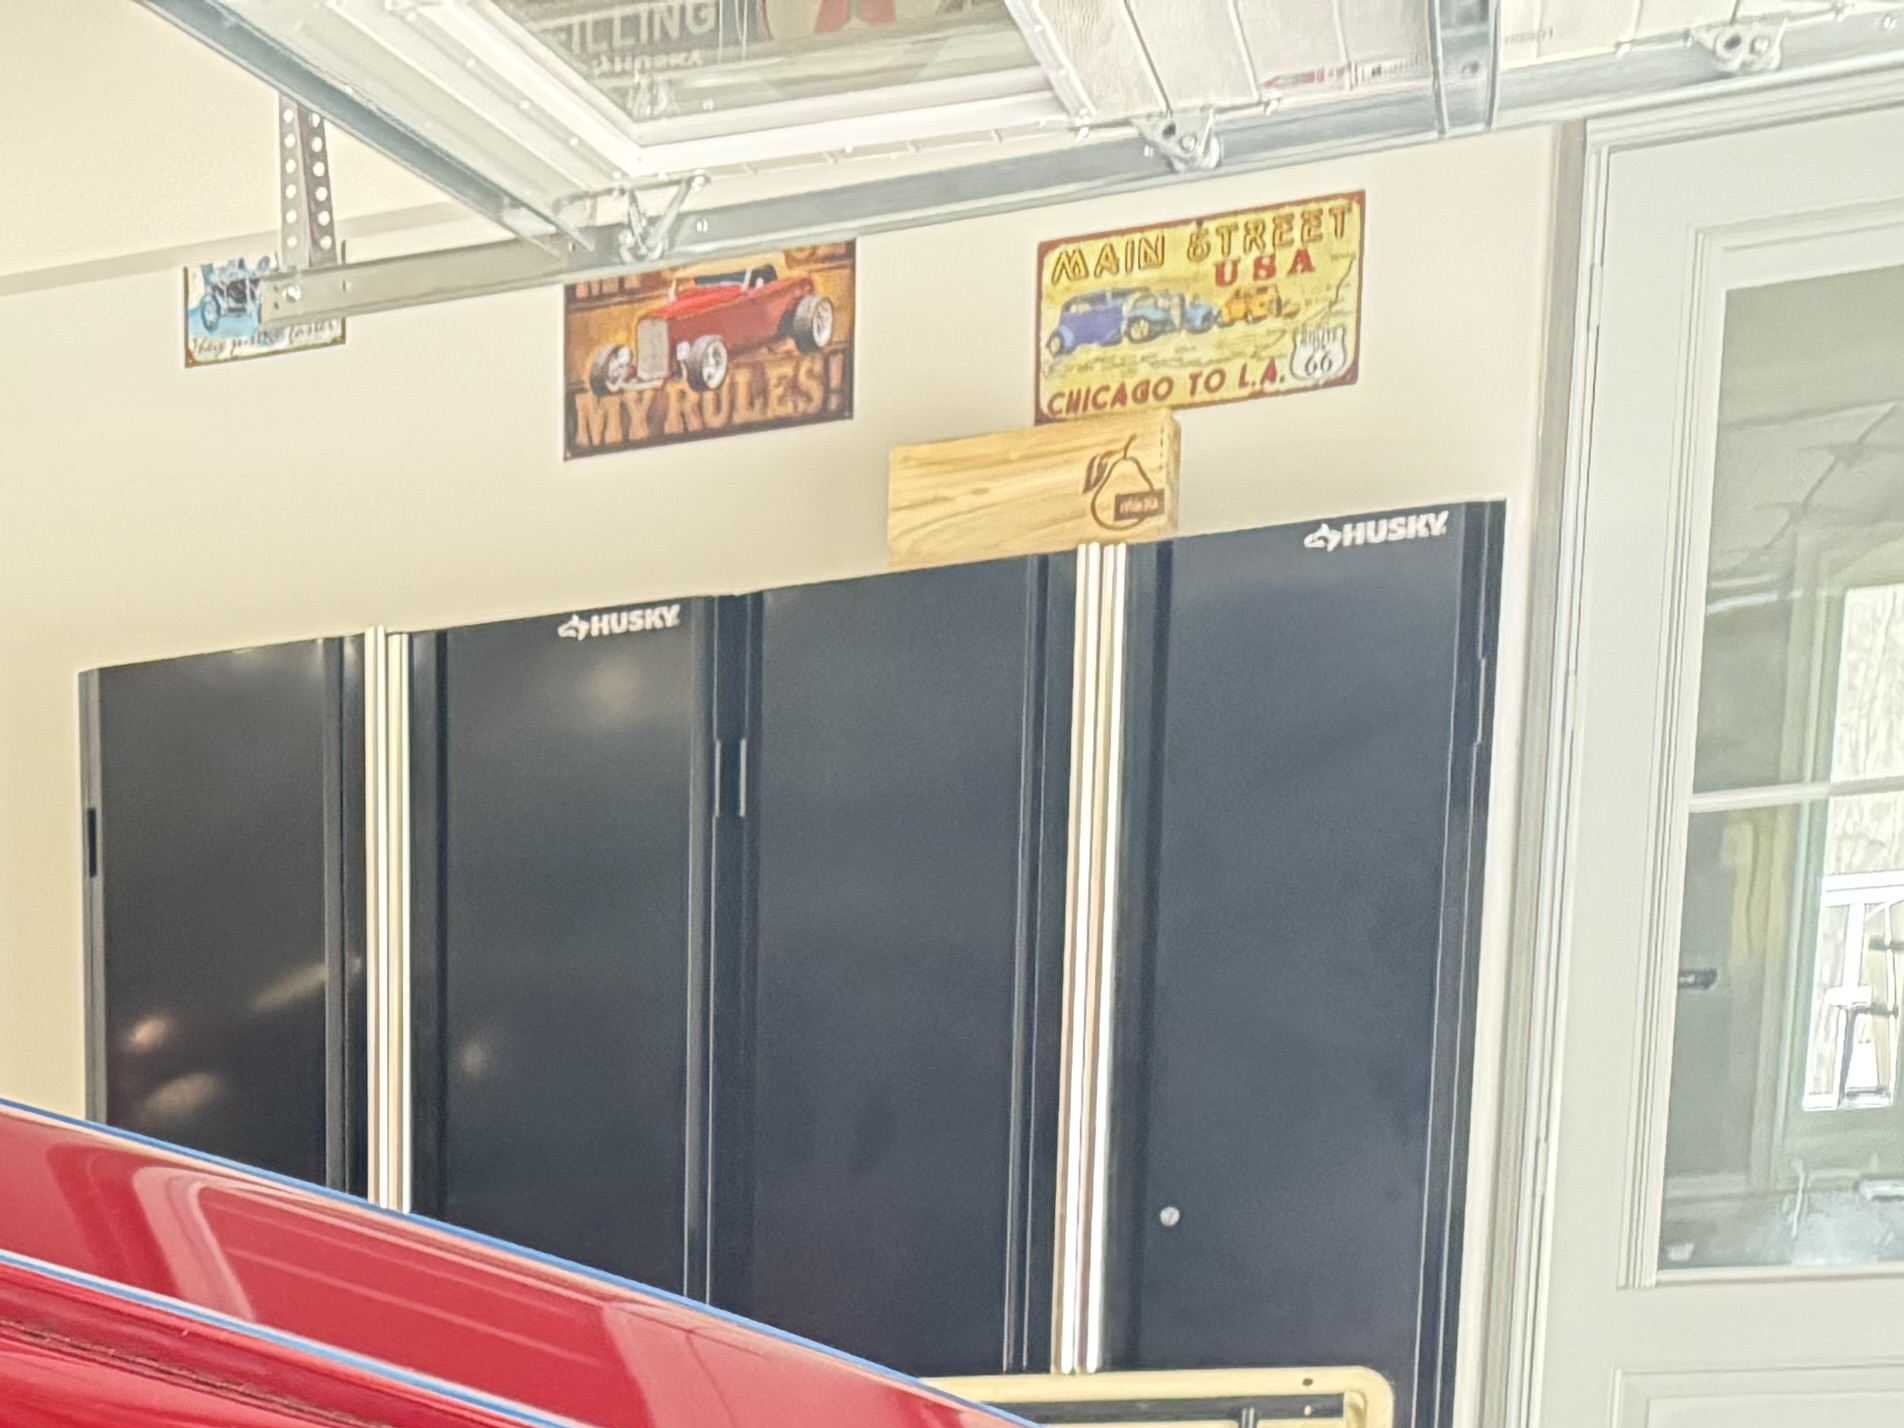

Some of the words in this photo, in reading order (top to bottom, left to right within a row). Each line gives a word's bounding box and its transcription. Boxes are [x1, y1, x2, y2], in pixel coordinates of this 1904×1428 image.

[560, 0, 716, 55] ILLING
[1051, 233, 1166, 286] MAIN
[1186, 205, 1353, 262] STREET
[1046, 375, 1174, 418] CHICAGO
[1189, 369, 1226, 394] TO
[1238, 357, 1286, 388] L.A.
[1305, 351, 1333, 376] 66
[576, 390, 657, 447] MY
[664, 353, 844, 434] RULES!
[1343, 510, 1449, 547] HUSKY
[591, 604, 681, 637] HUSKY
